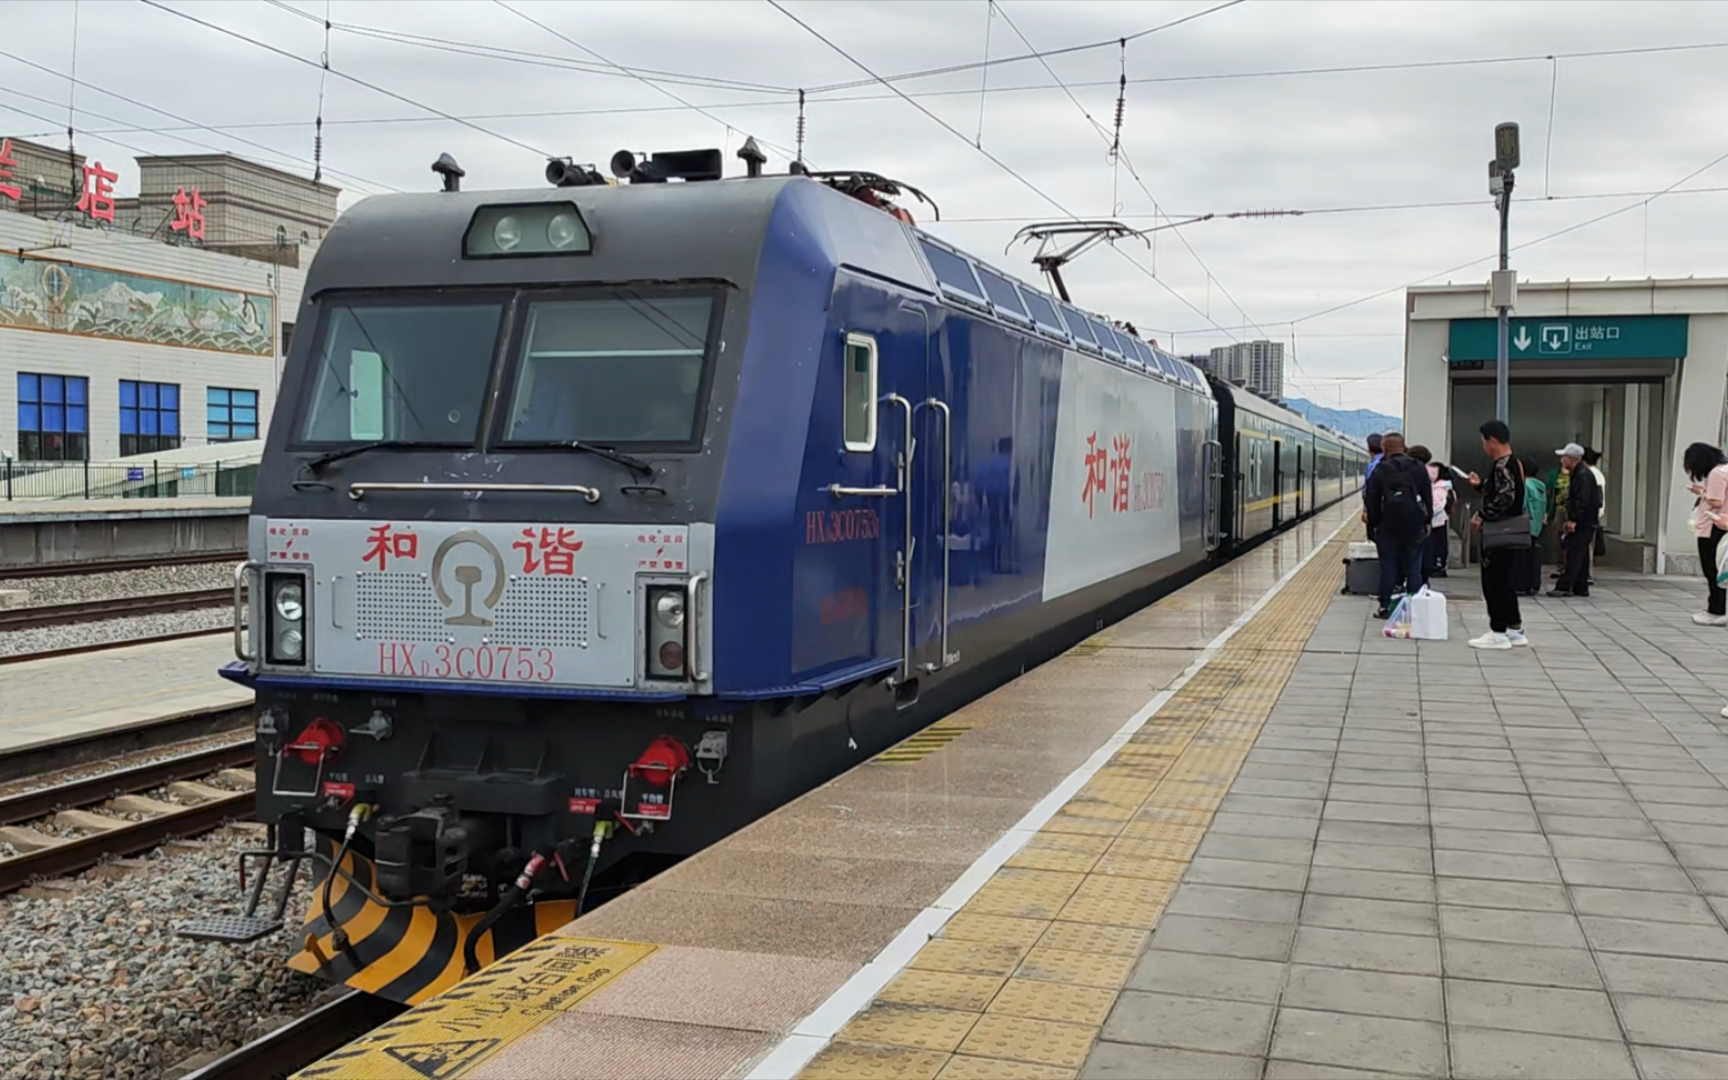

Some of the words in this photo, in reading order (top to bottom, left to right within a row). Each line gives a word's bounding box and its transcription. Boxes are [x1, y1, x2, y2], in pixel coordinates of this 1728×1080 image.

[1575, 326, 1620, 340] 出站口
[1575, 342, 1592, 351] Exit
[1081, 431, 1132, 520] 和谐
[362, 523, 418, 572] 和
[513, 526, 584, 576] 谐
